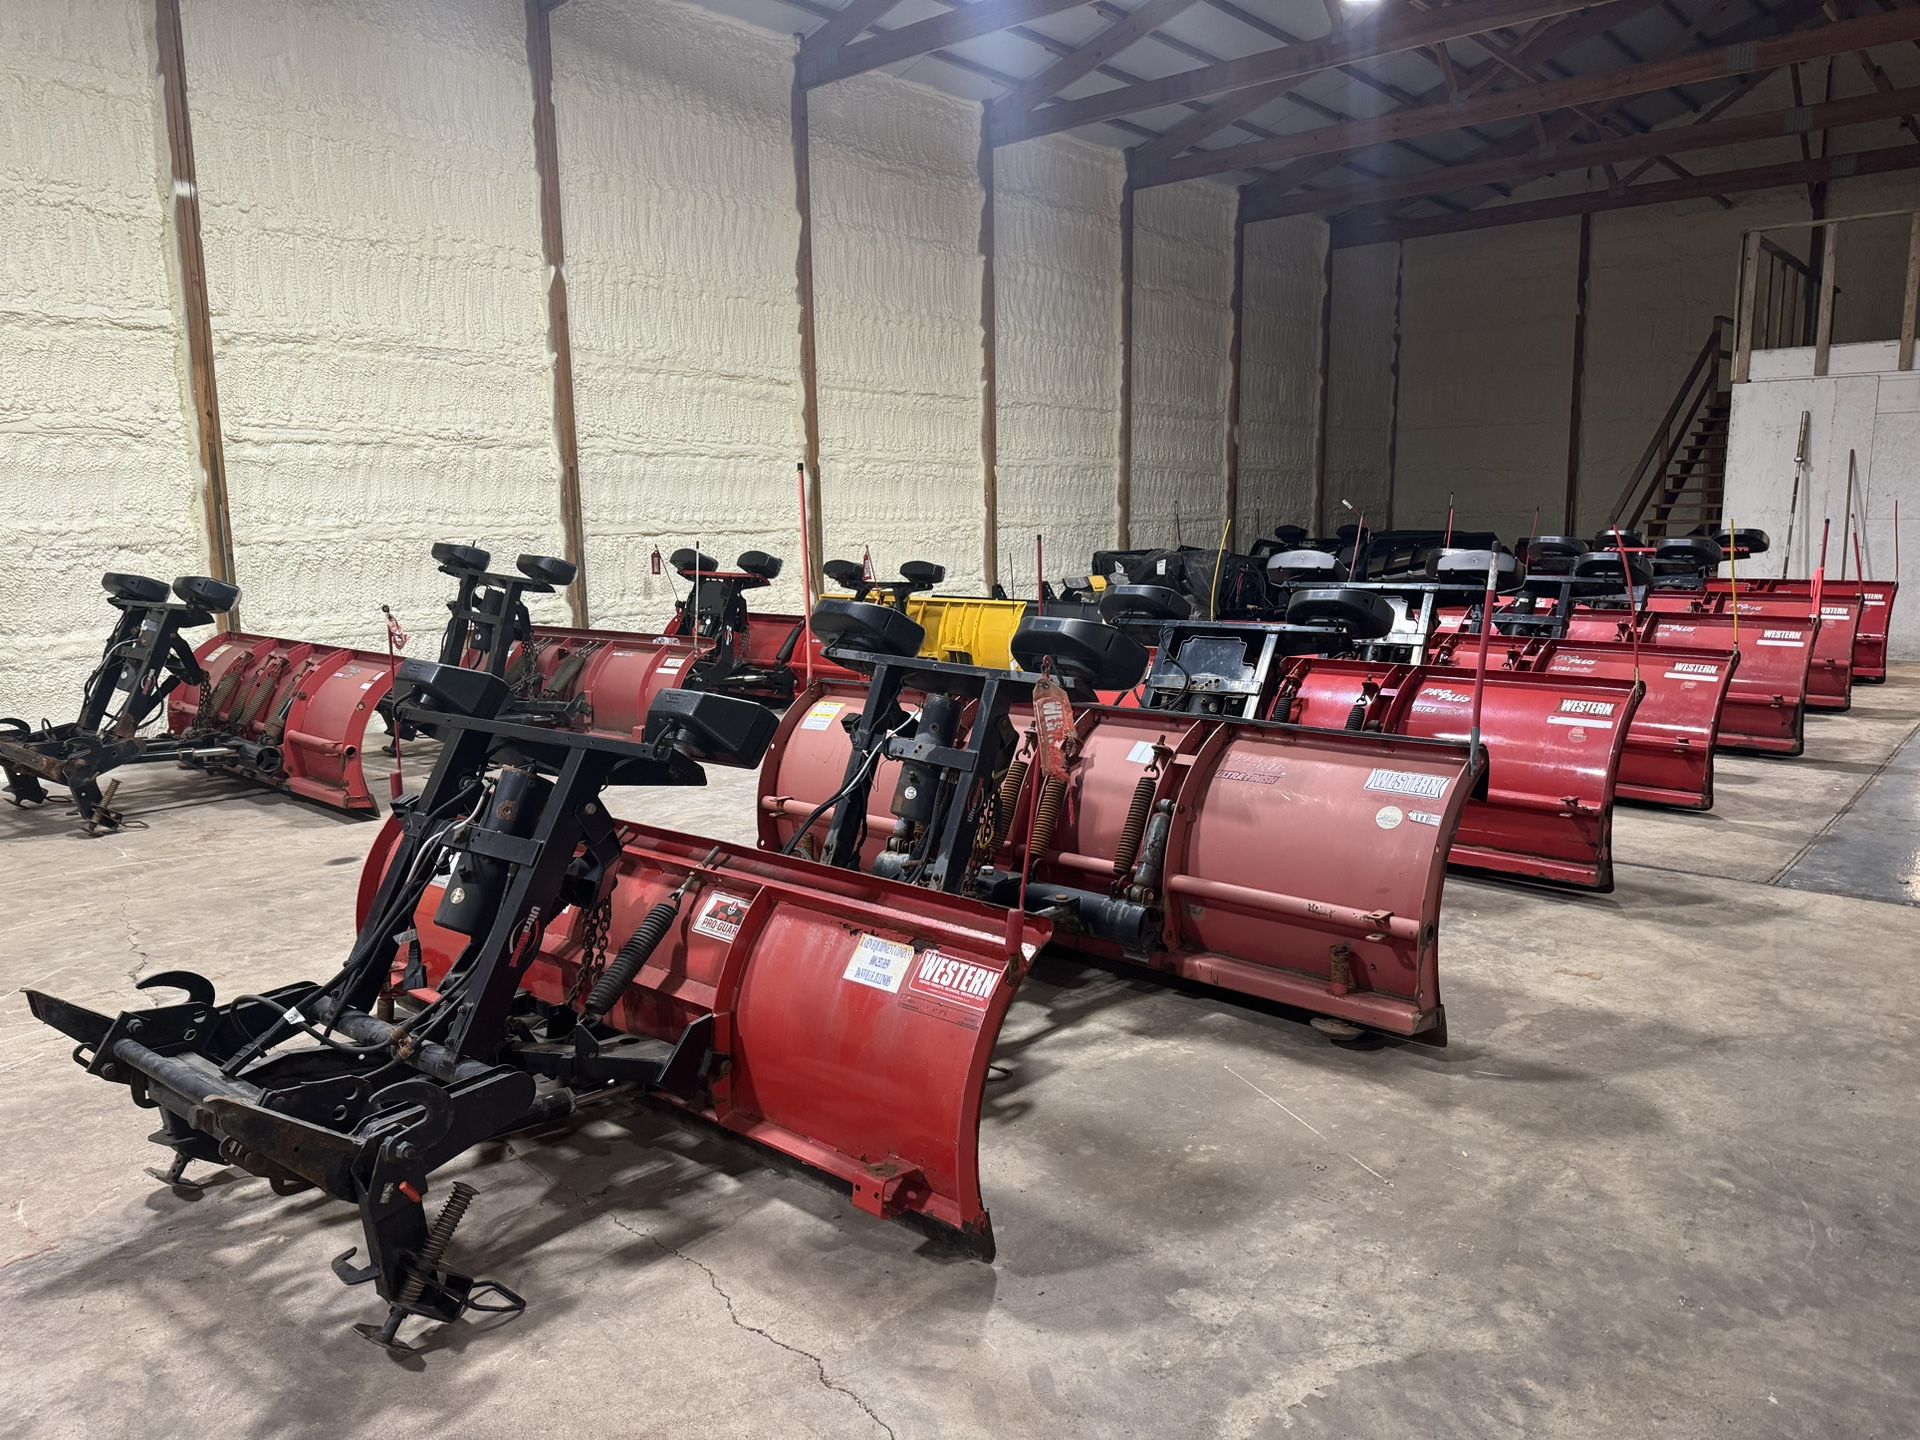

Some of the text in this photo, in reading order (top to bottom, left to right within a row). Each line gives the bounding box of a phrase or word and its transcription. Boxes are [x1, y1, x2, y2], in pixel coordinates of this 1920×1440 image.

[1821, 607, 1848, 615] ESTERN
[1764, 630, 1801, 639] WESTERN
[1674, 662, 1718, 674] WESTERN
[1420, 688, 1471, 703] PRO PLUS
[1412, 704, 1437, 713] ULTRA
[1561, 699, 1614, 715] WESTERN
[1372, 771, 1441, 796] WESTERN
[701, 918, 739, 935] PRO-GUAR
[918, 952, 1000, 998] WESTERN
